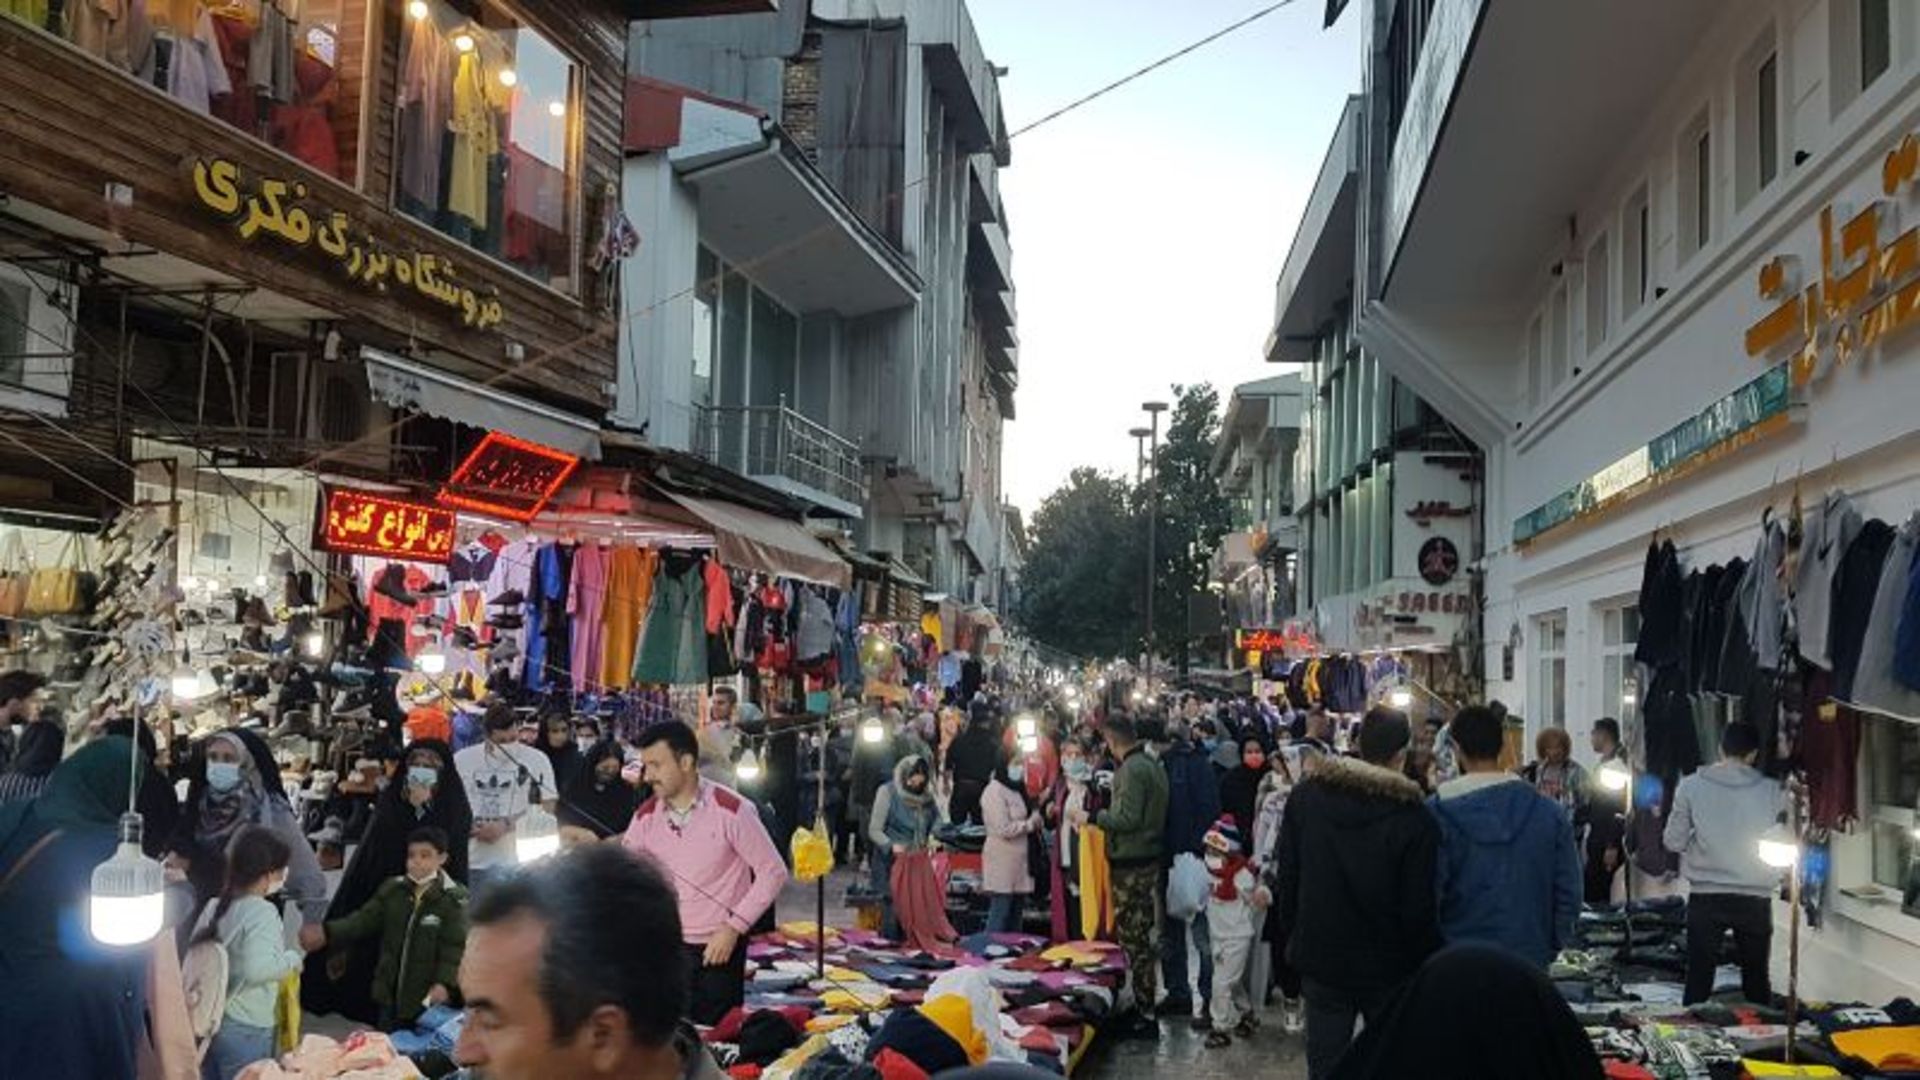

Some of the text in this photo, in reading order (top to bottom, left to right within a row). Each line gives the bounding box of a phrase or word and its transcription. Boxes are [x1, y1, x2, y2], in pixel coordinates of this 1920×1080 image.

[194, 160, 502, 329] فروشگاه بزرگ فکری
[377, 508, 428, 551] انواع
